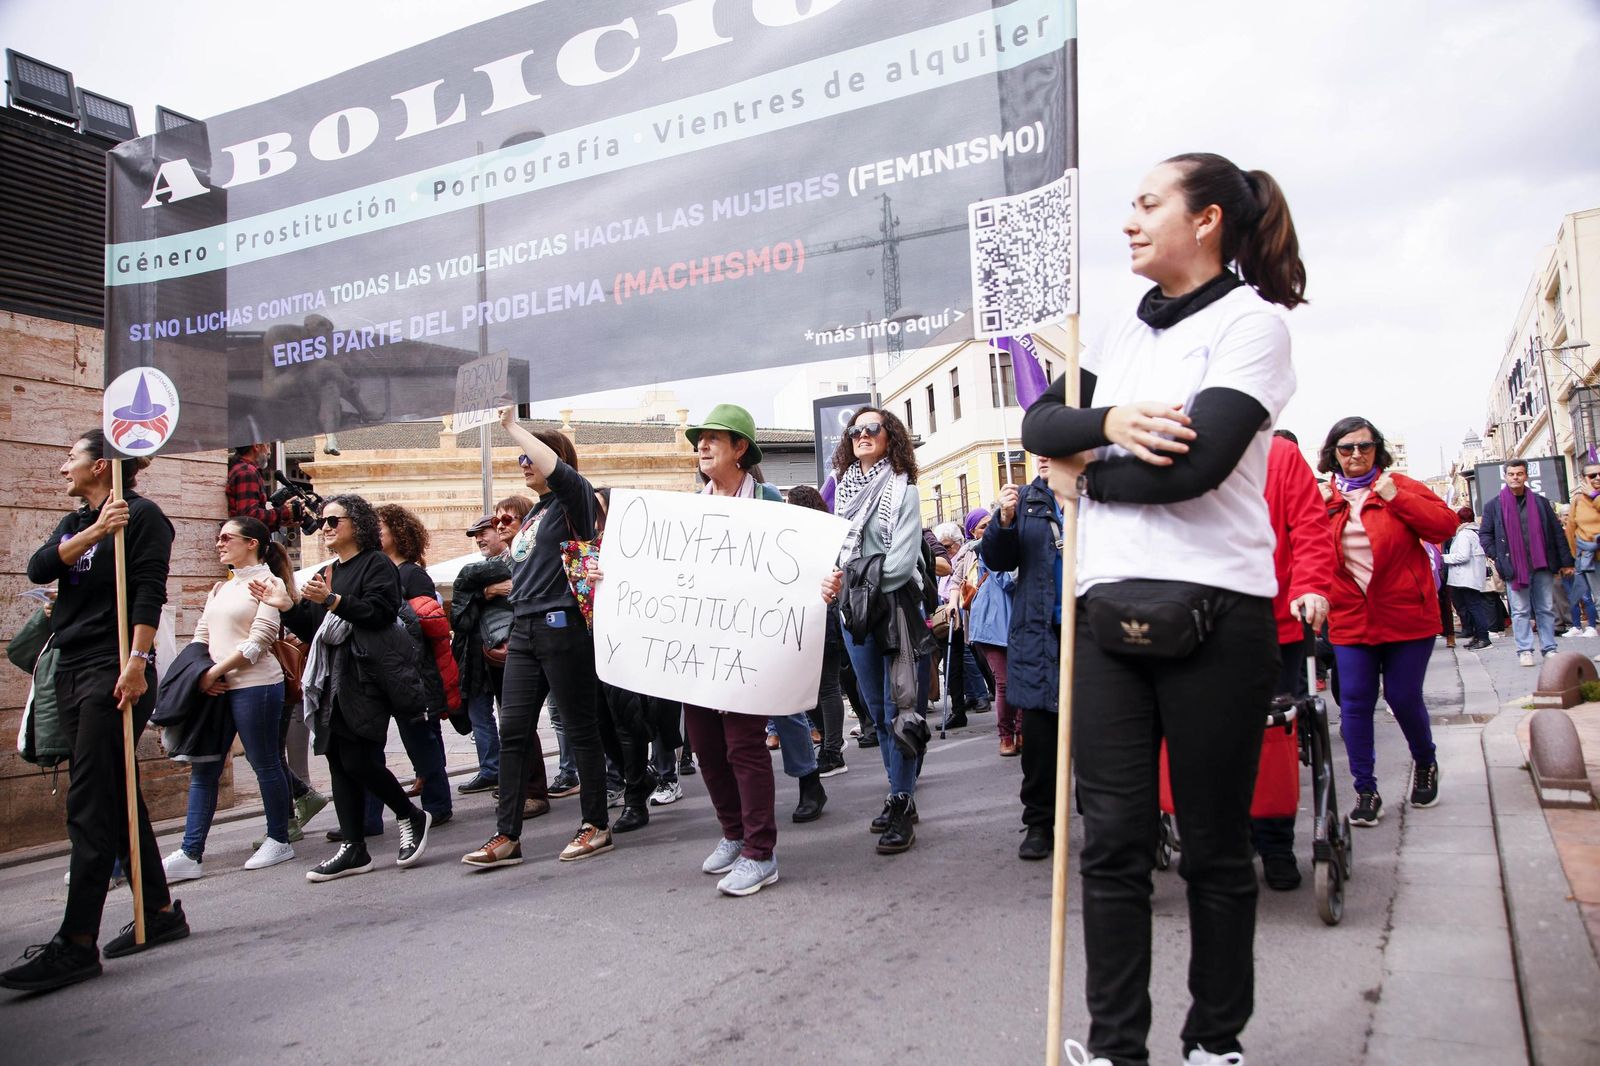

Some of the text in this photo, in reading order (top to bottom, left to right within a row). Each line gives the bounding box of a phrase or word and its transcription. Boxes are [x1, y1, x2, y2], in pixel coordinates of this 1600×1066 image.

[117, 15, 1049, 274] Género Prostitución Pornografía Vientres de alquiler
[129, 121, 1045, 342] SI NO LUCHAS CONTRA TODAS LAS VIOLENCIAS HACIA LAS MUJERES (FEMINISMO)
[273, 238, 806, 367] ERES PARTE DEL PROBLEMA (MACHISMO)
[861, 318, 900, 341] info
[906, 308, 950, 338] aquí
[462, 357, 503, 393] PORNO
[677, 573, 695, 590] es
[617, 580, 806, 651] PROSTITUCIÓN
[606, 634, 621, 664] Y
